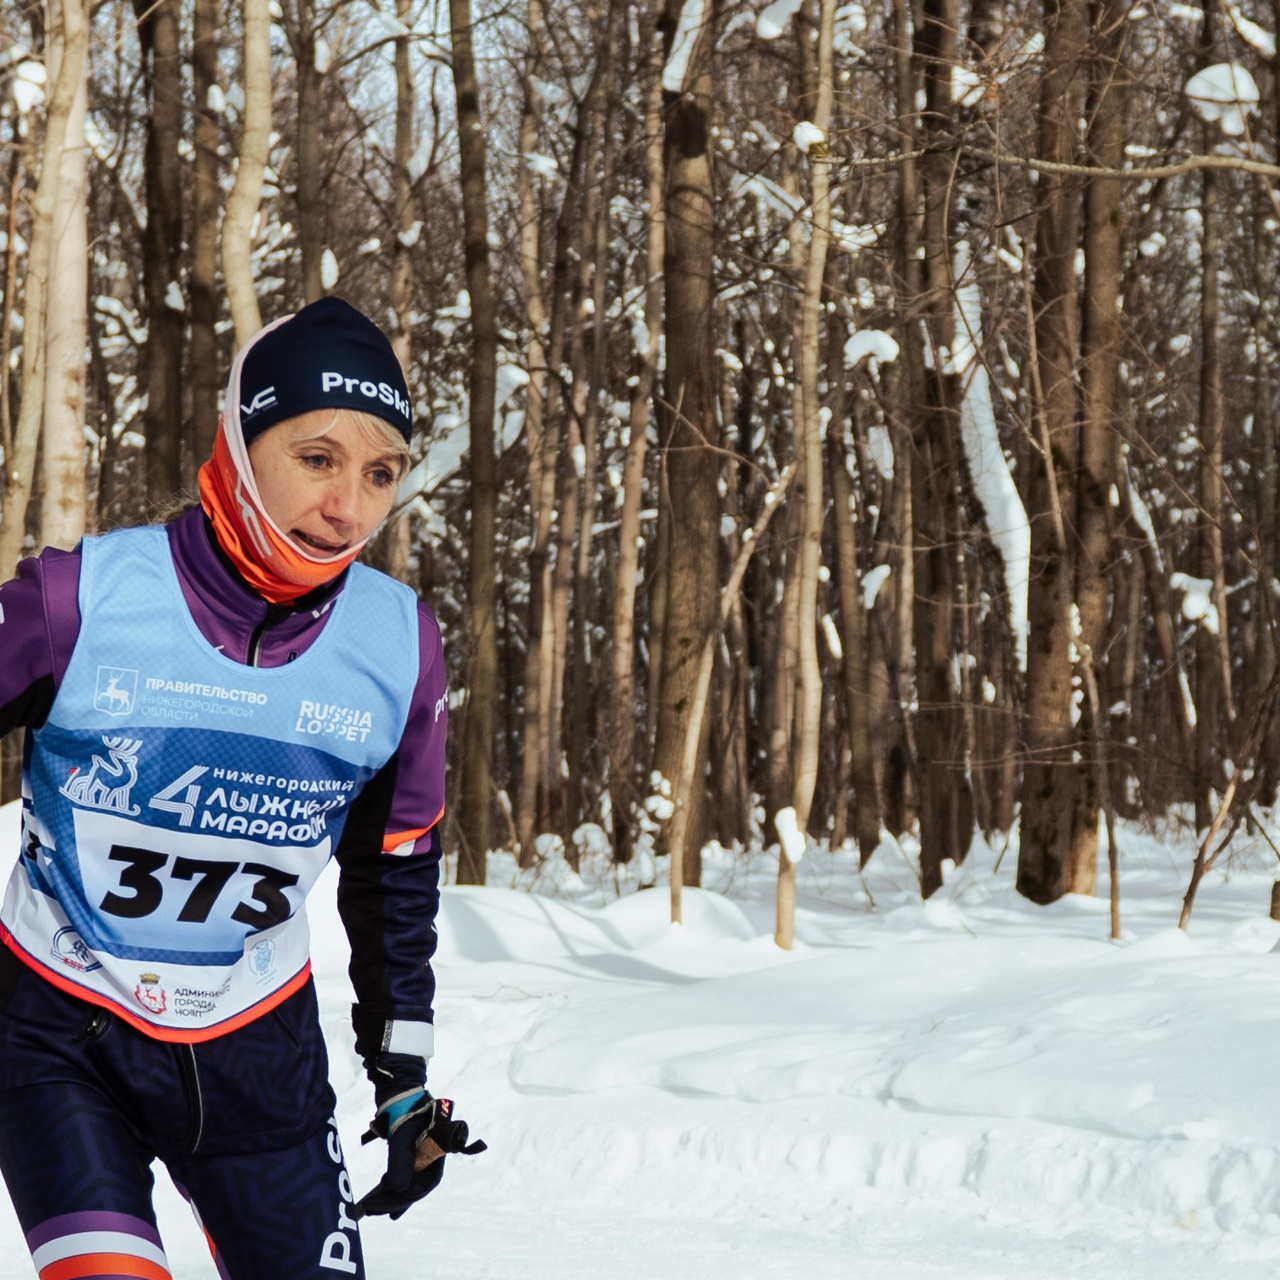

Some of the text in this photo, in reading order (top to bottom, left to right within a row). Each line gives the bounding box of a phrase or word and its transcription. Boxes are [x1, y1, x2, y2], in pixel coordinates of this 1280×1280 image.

[322, 372, 410, 418] ProSki
[145, 677, 268, 705] ПРАВИТЕЛЬСТВО
[140, 706, 199, 722] ОБЛАСТИ
[142, 694, 254, 719] НИЖЕГОРОДСКОЙ
[299, 700, 372, 727] RUSSIA
[295, 718, 370, 743] LOPPET
[98, 844, 300, 930] 373
